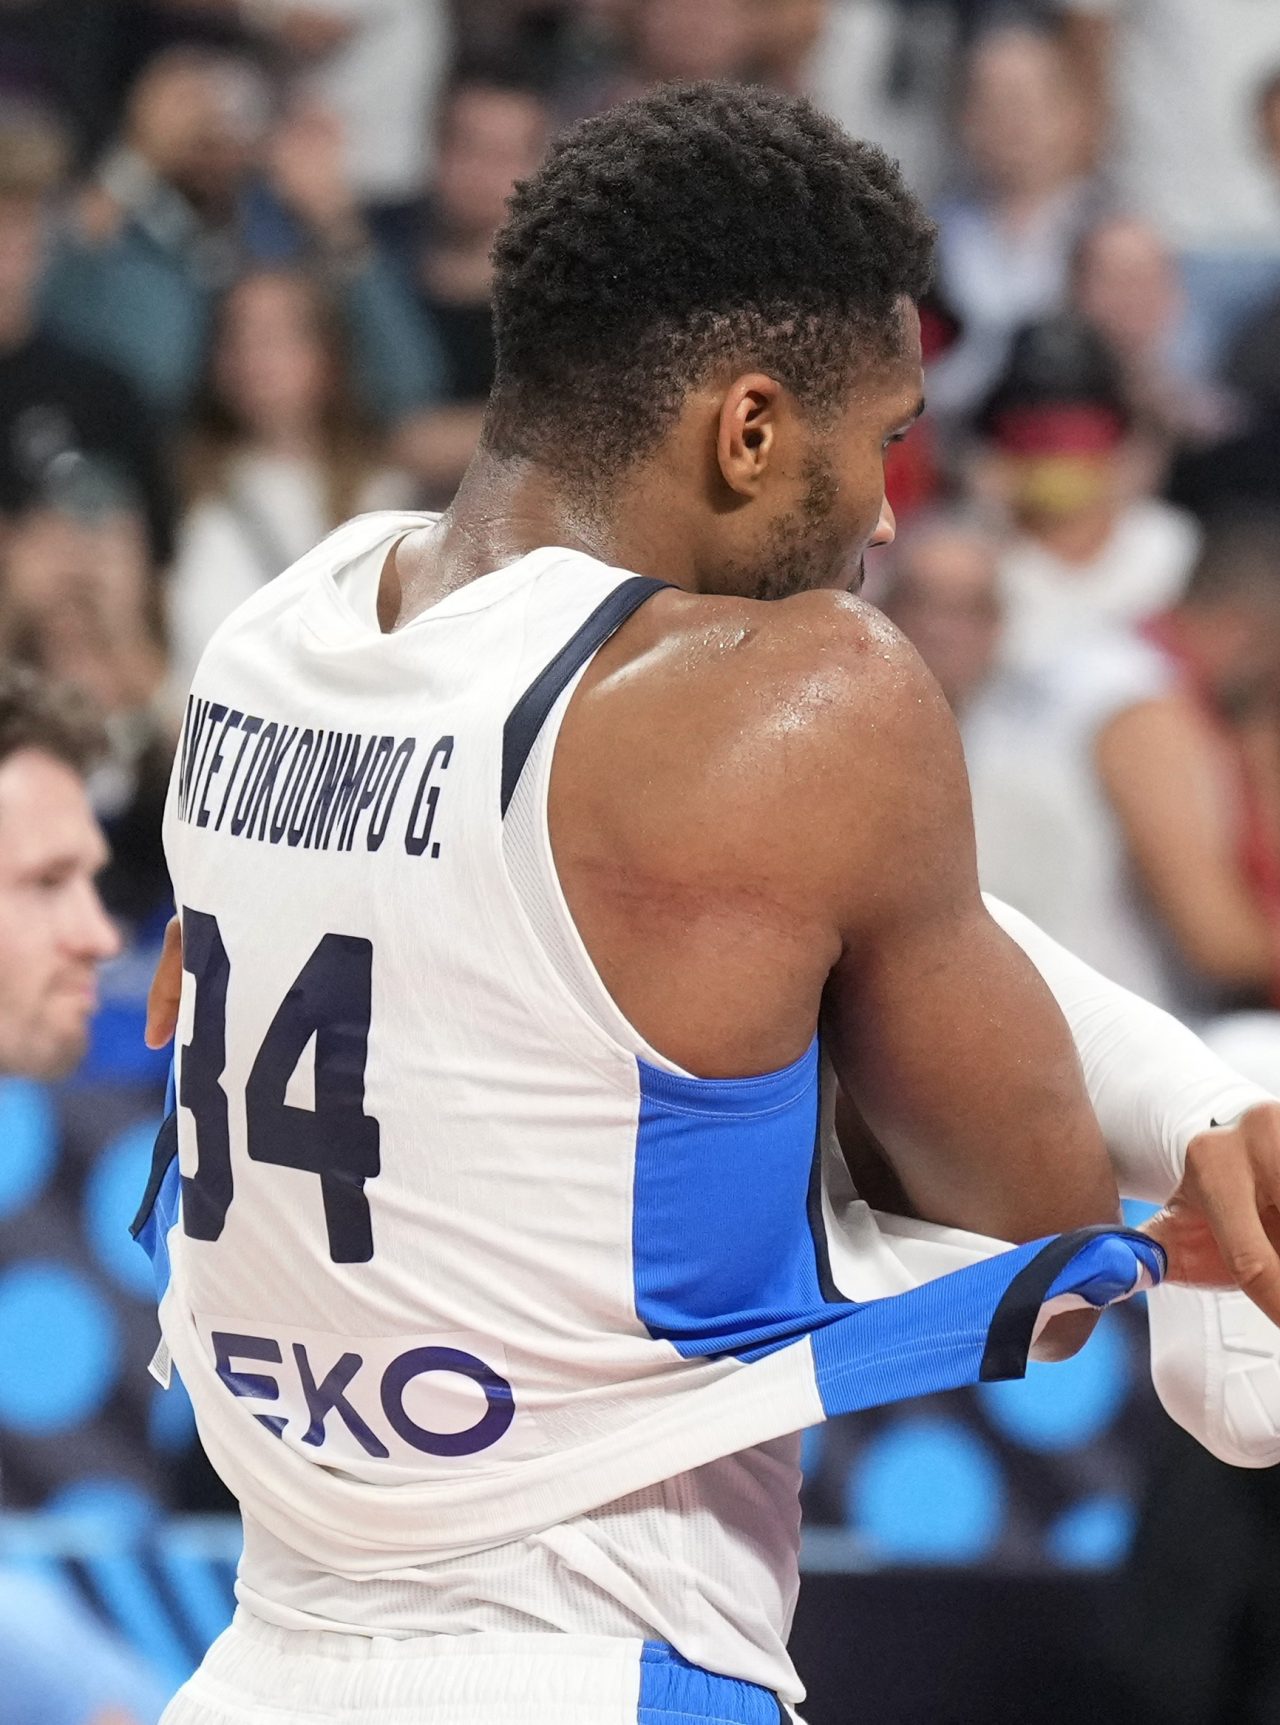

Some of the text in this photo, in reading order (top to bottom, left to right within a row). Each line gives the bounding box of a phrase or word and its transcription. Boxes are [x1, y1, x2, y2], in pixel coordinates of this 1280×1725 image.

[404, 735, 454, 858] G.
[180, 904, 380, 1264] 34
[211, 1330, 516, 1458] EKO
